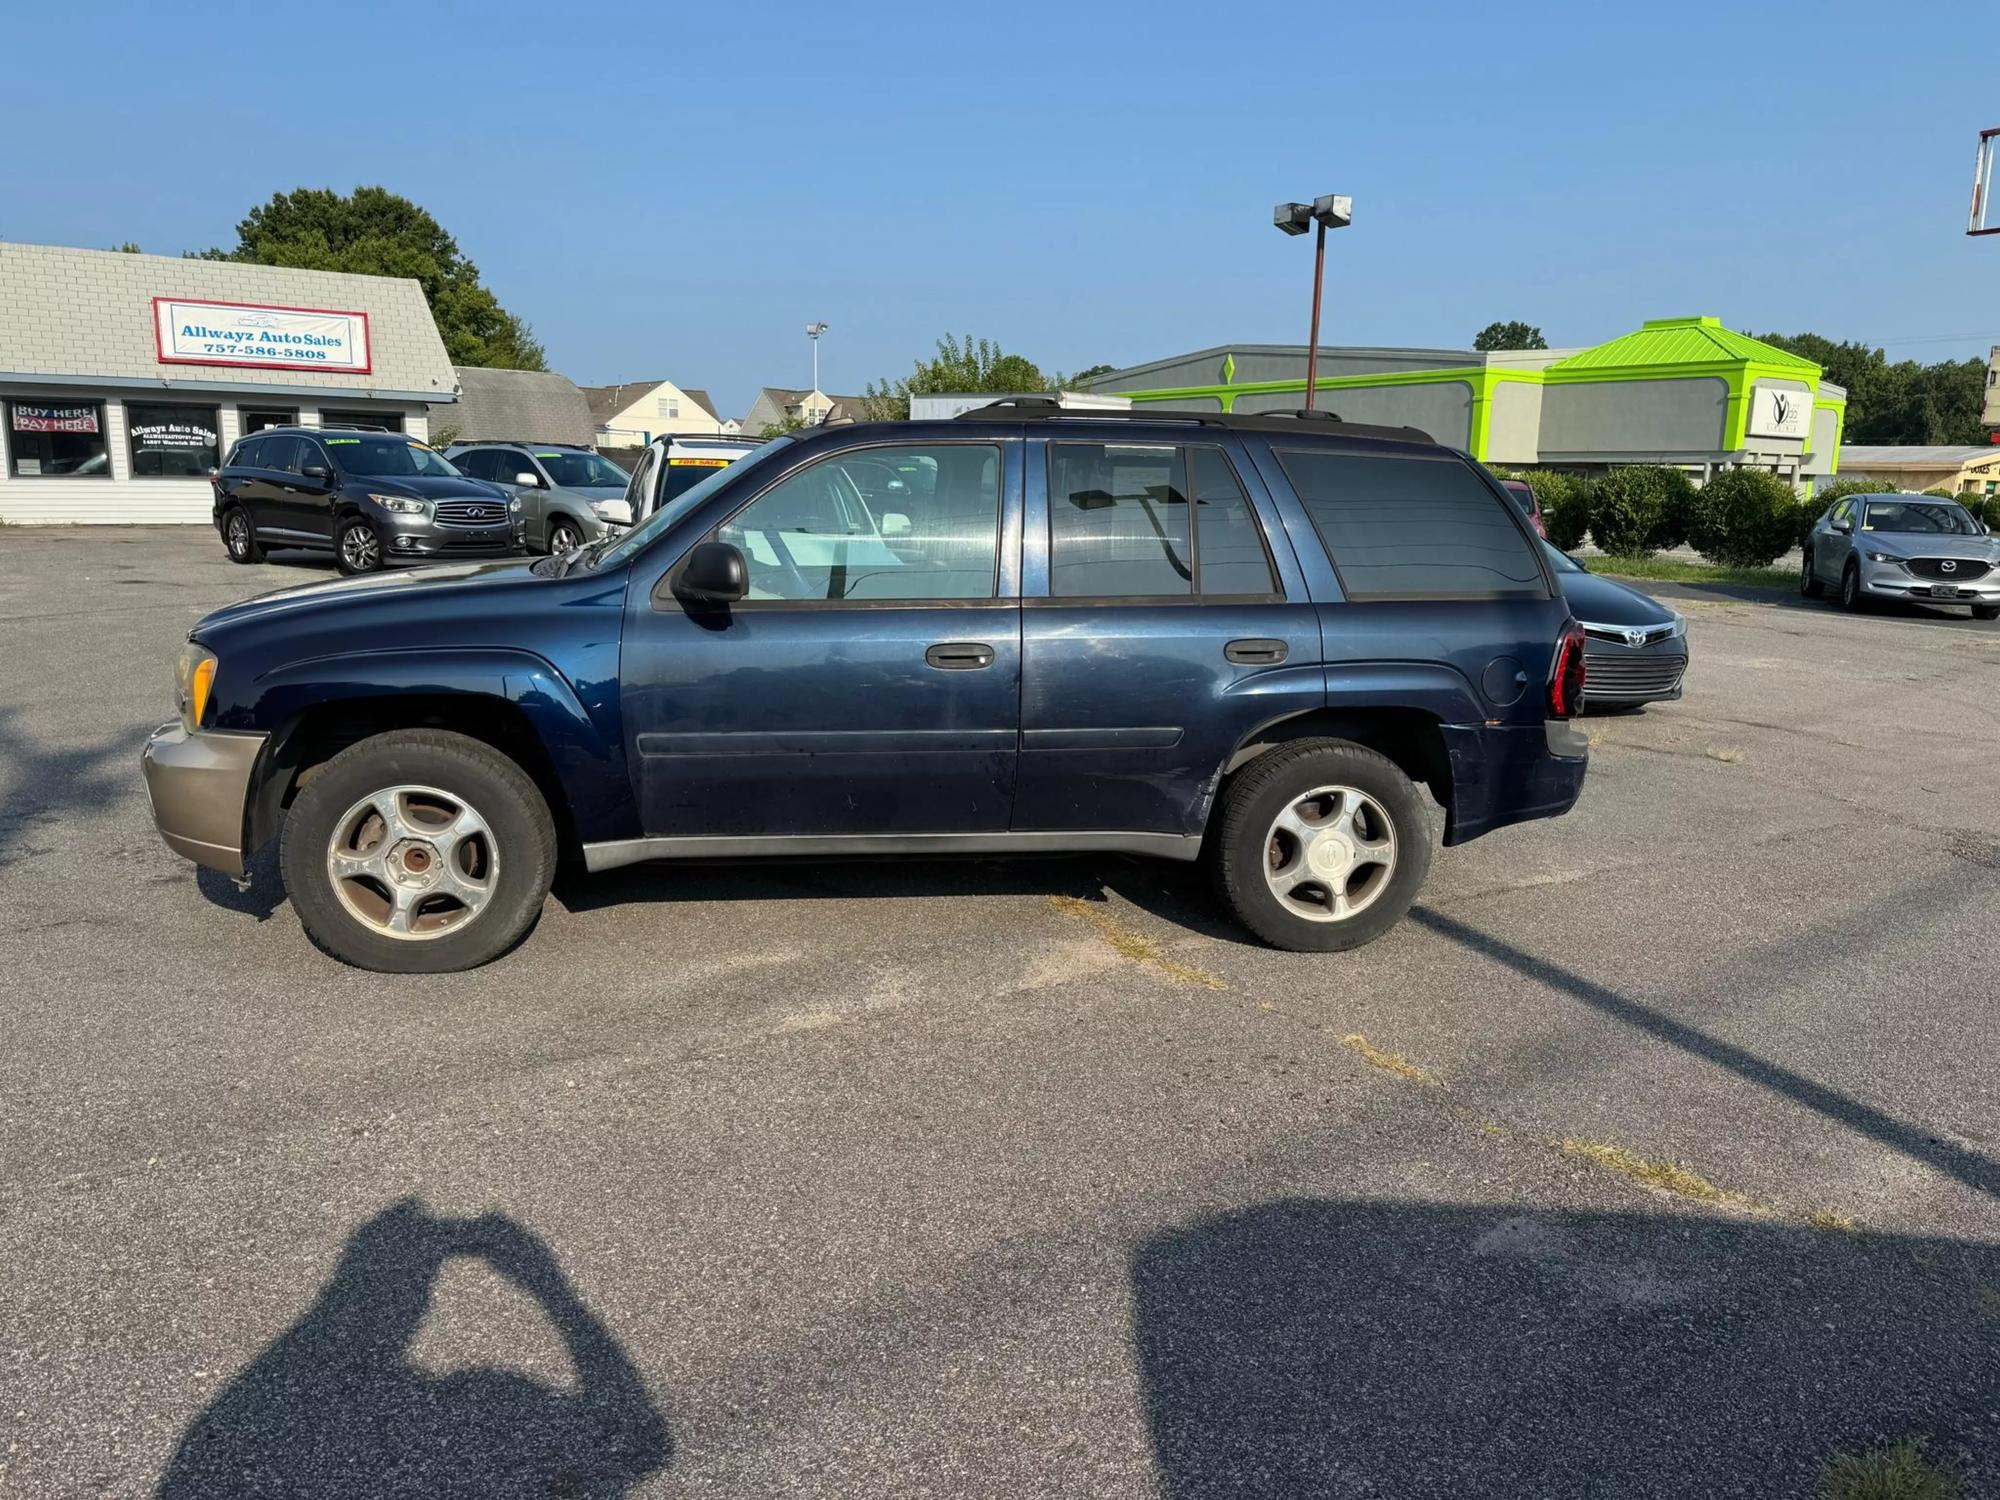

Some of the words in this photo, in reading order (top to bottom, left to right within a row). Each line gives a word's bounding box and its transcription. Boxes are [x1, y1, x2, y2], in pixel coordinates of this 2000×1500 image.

[181, 325, 254, 343] Allwayz
[204, 343, 326, 359] 757-586-5808
[18, 406, 48, 417] BUY
[54, 409, 90, 418] HERE
[20, 417, 48, 429] PAY
[54, 420, 90, 430] HERE
[130, 425, 167, 437] Allwayz
[168, 424, 191, 433] Auto
[192, 426, 217, 440] Sales
